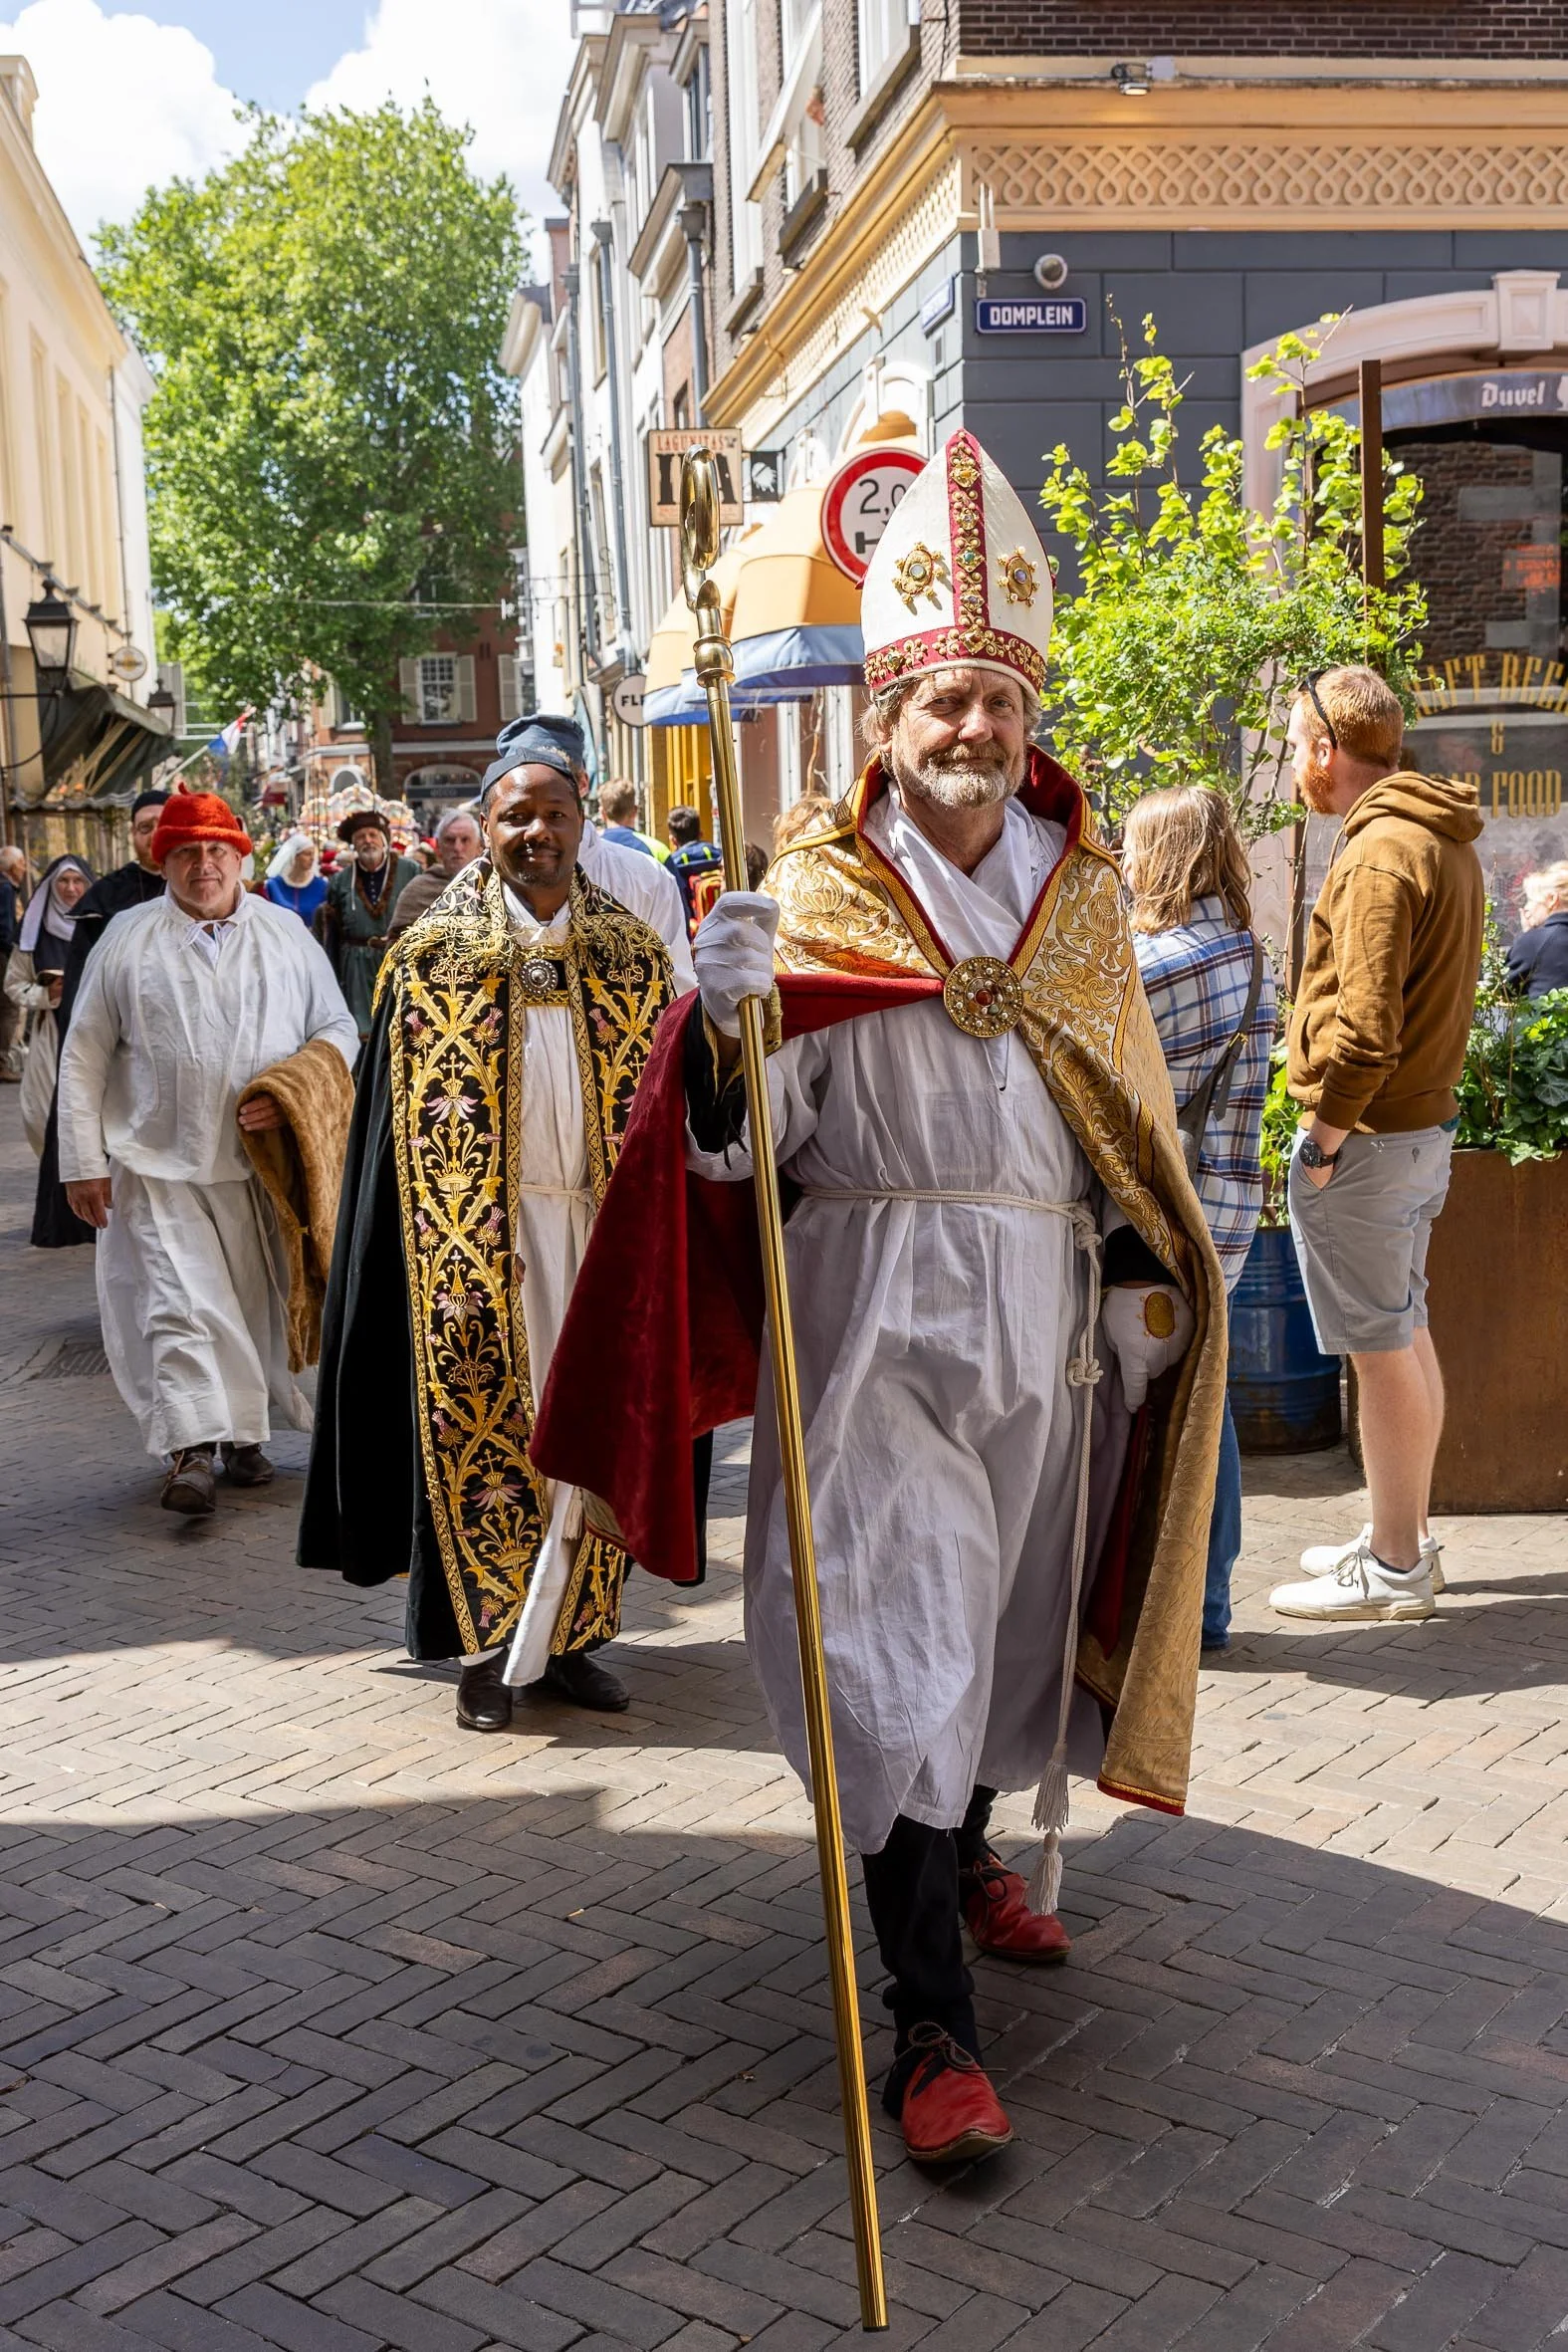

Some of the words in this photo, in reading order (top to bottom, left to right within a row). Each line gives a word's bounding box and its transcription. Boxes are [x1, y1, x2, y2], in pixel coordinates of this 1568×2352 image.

[990, 306, 1073, 326] DOMPLEIN
[1481, 379, 1546, 407] Duvel
[657, 434, 725, 451] LAGUNITAS
[655, 453, 738, 505] IA
[1492, 769, 1562, 819] FOOD
